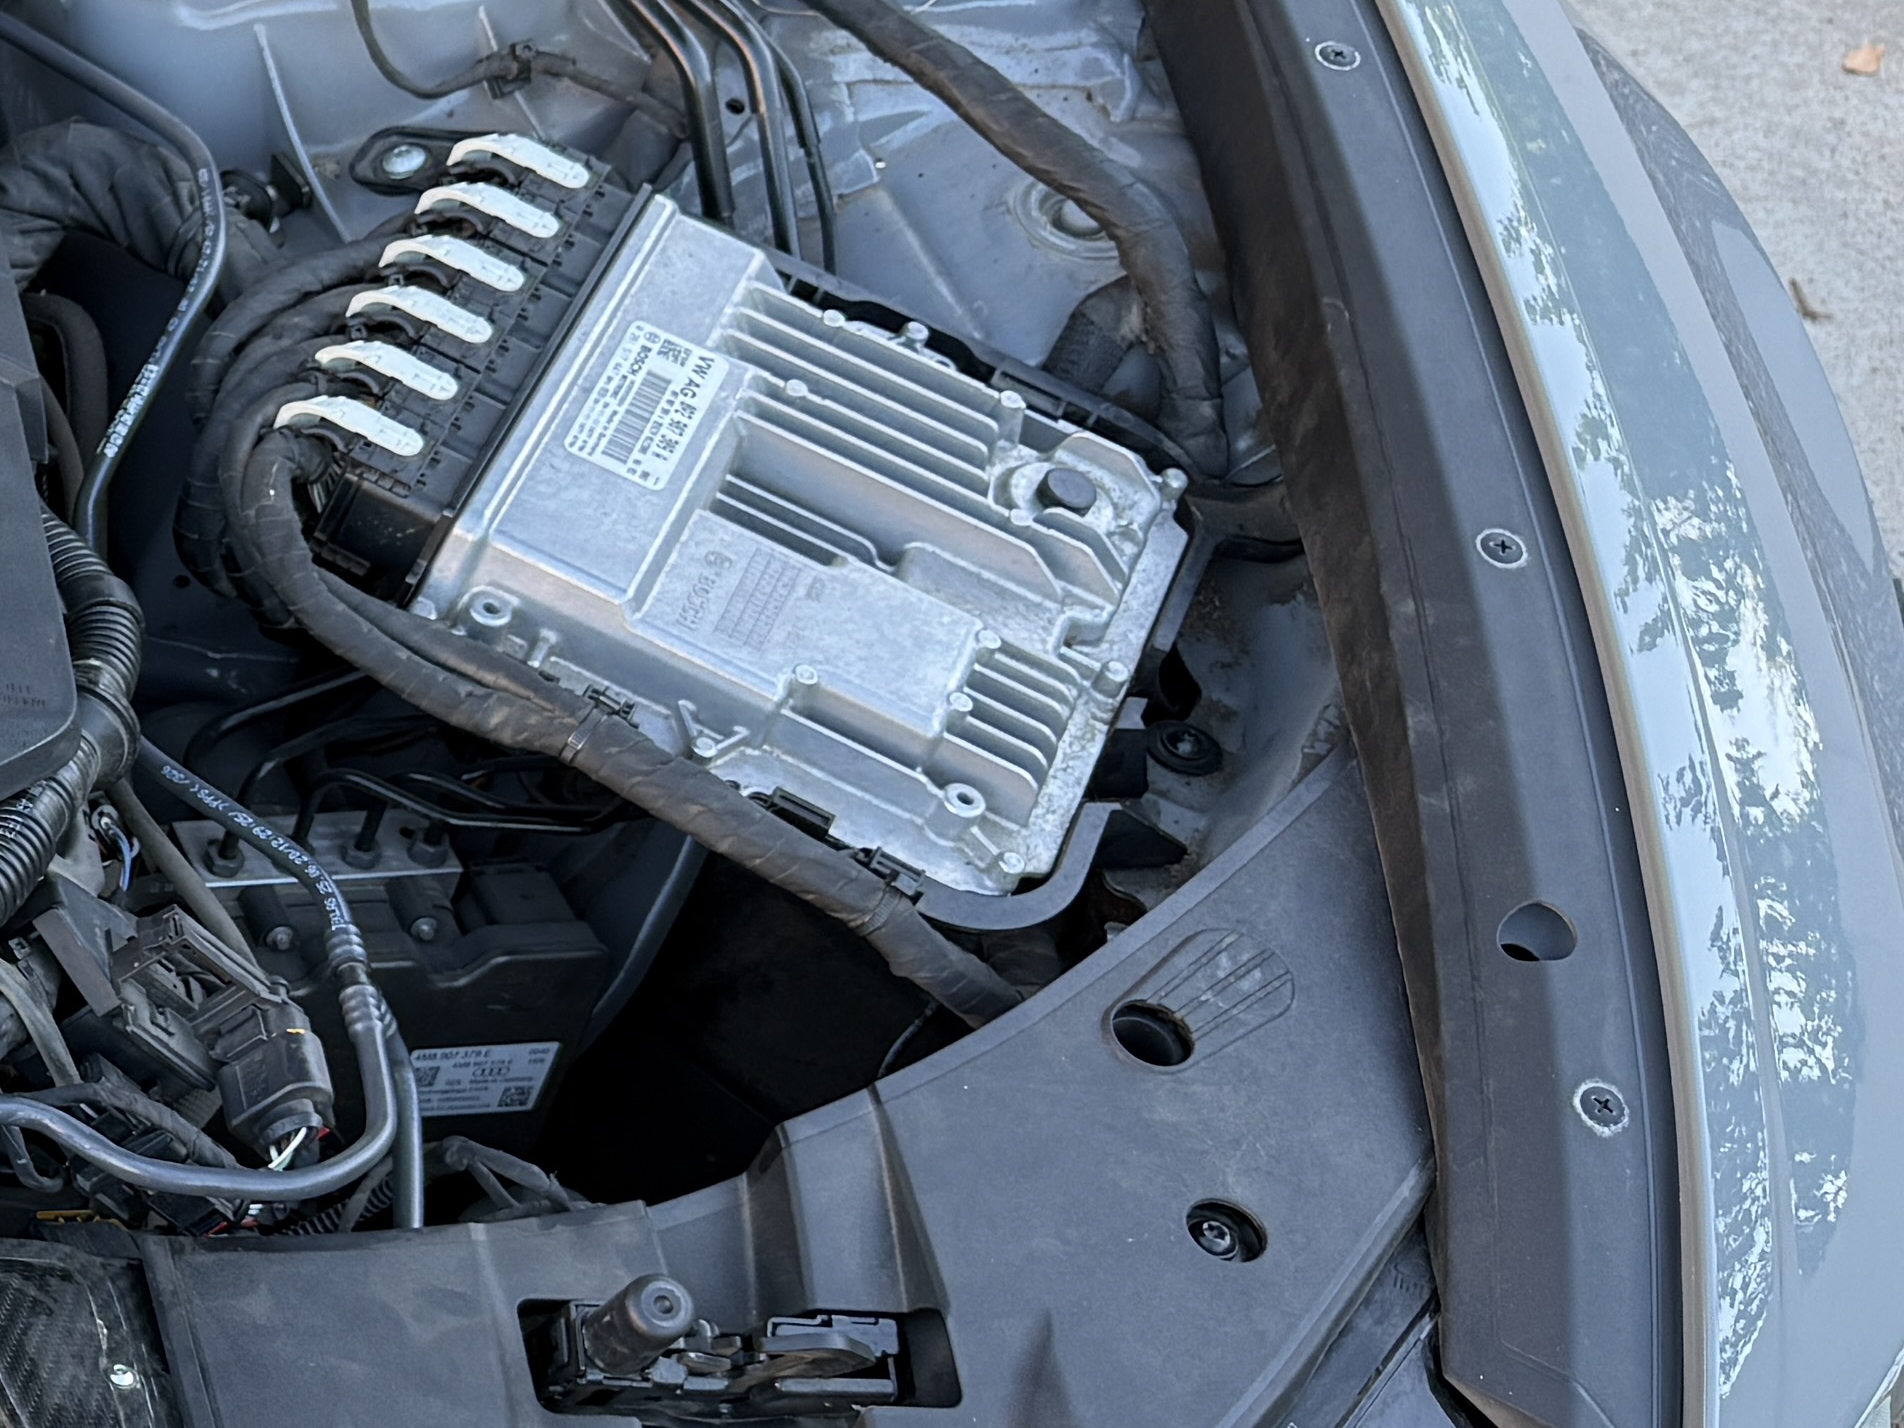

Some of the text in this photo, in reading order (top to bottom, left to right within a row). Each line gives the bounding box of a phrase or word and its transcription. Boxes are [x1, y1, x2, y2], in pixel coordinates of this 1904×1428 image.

[626, 344, 652, 376] BOSCH
[690, 353, 715, 379] VW
[678, 376, 702, 400] AG
